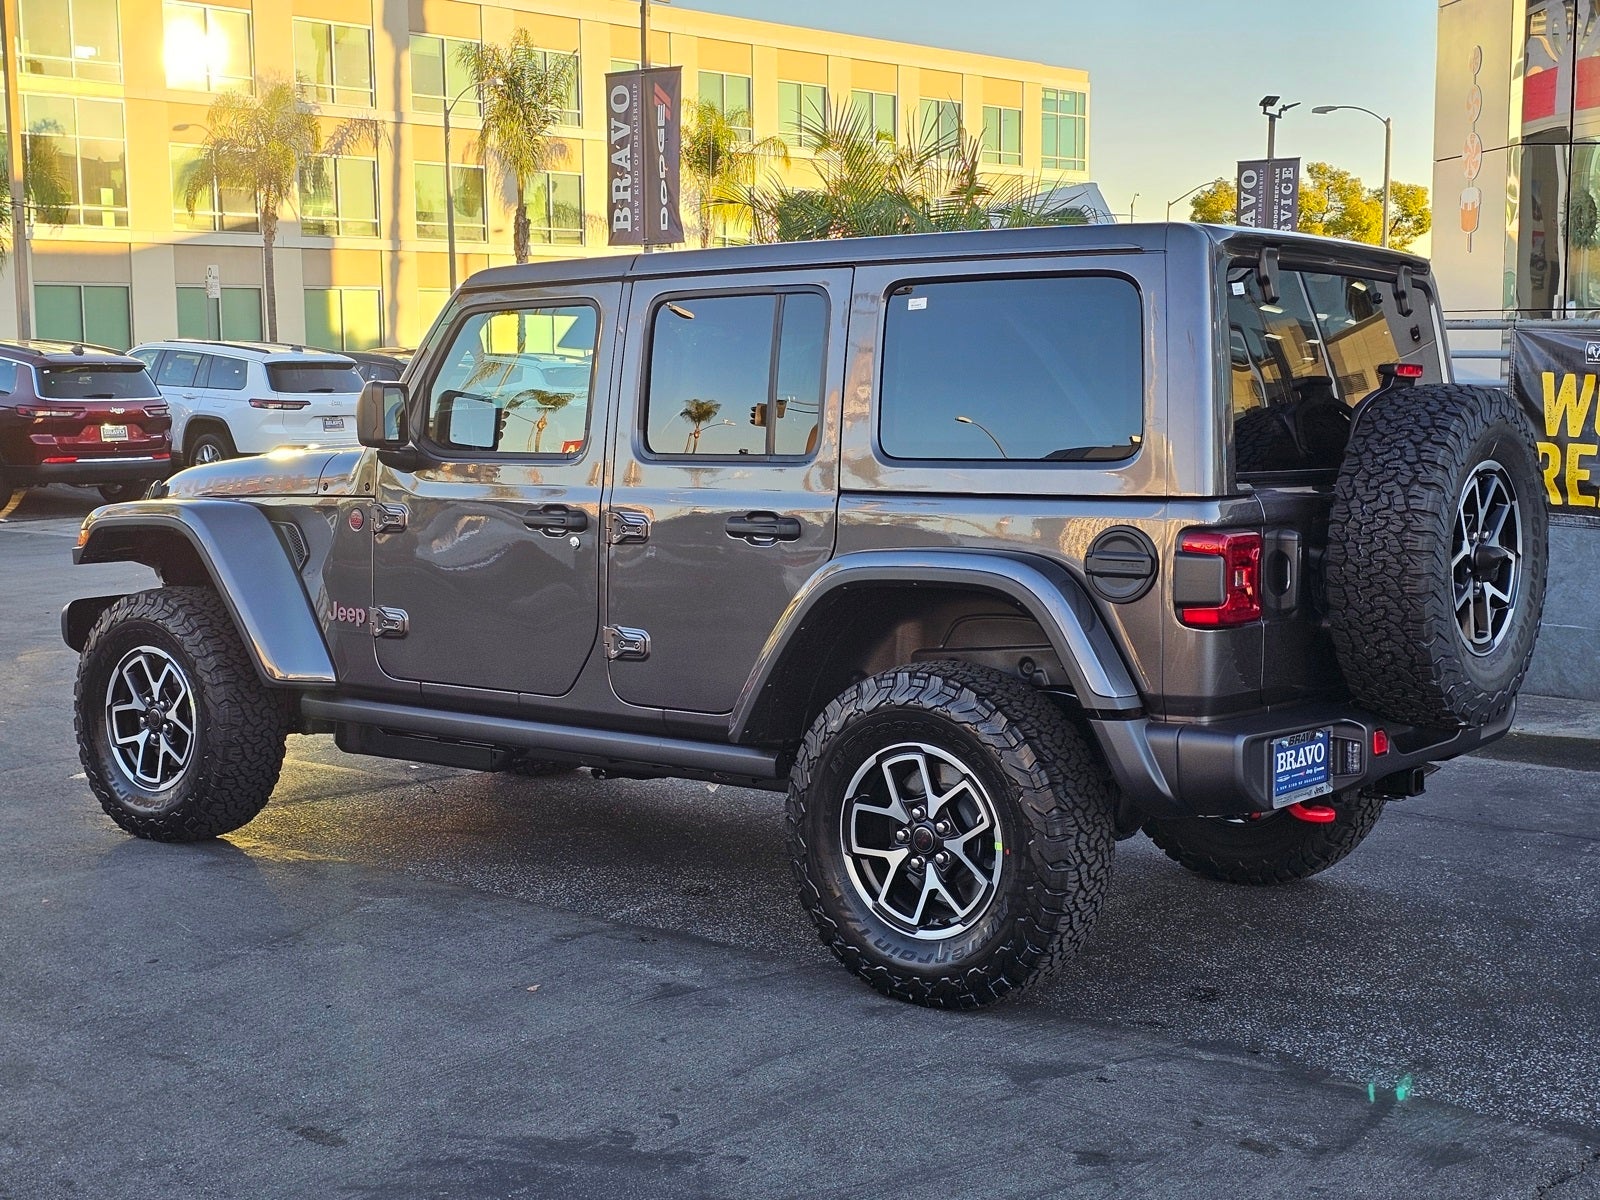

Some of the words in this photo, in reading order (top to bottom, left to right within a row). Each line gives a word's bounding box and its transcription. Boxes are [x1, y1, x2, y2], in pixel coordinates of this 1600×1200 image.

[611, 85, 631, 232] BRAVO
[633, 153, 639, 165] OF
[658, 104, 668, 230] DODGE
[1241, 170, 1257, 227] AVO
[1281, 168, 1293, 231] RVICE
[1542, 372, 1600, 438] W
[1536, 441, 1600, 508] RE
[327, 601, 366, 627] Jeep
[1276, 742, 1325, 773] BRAVO
